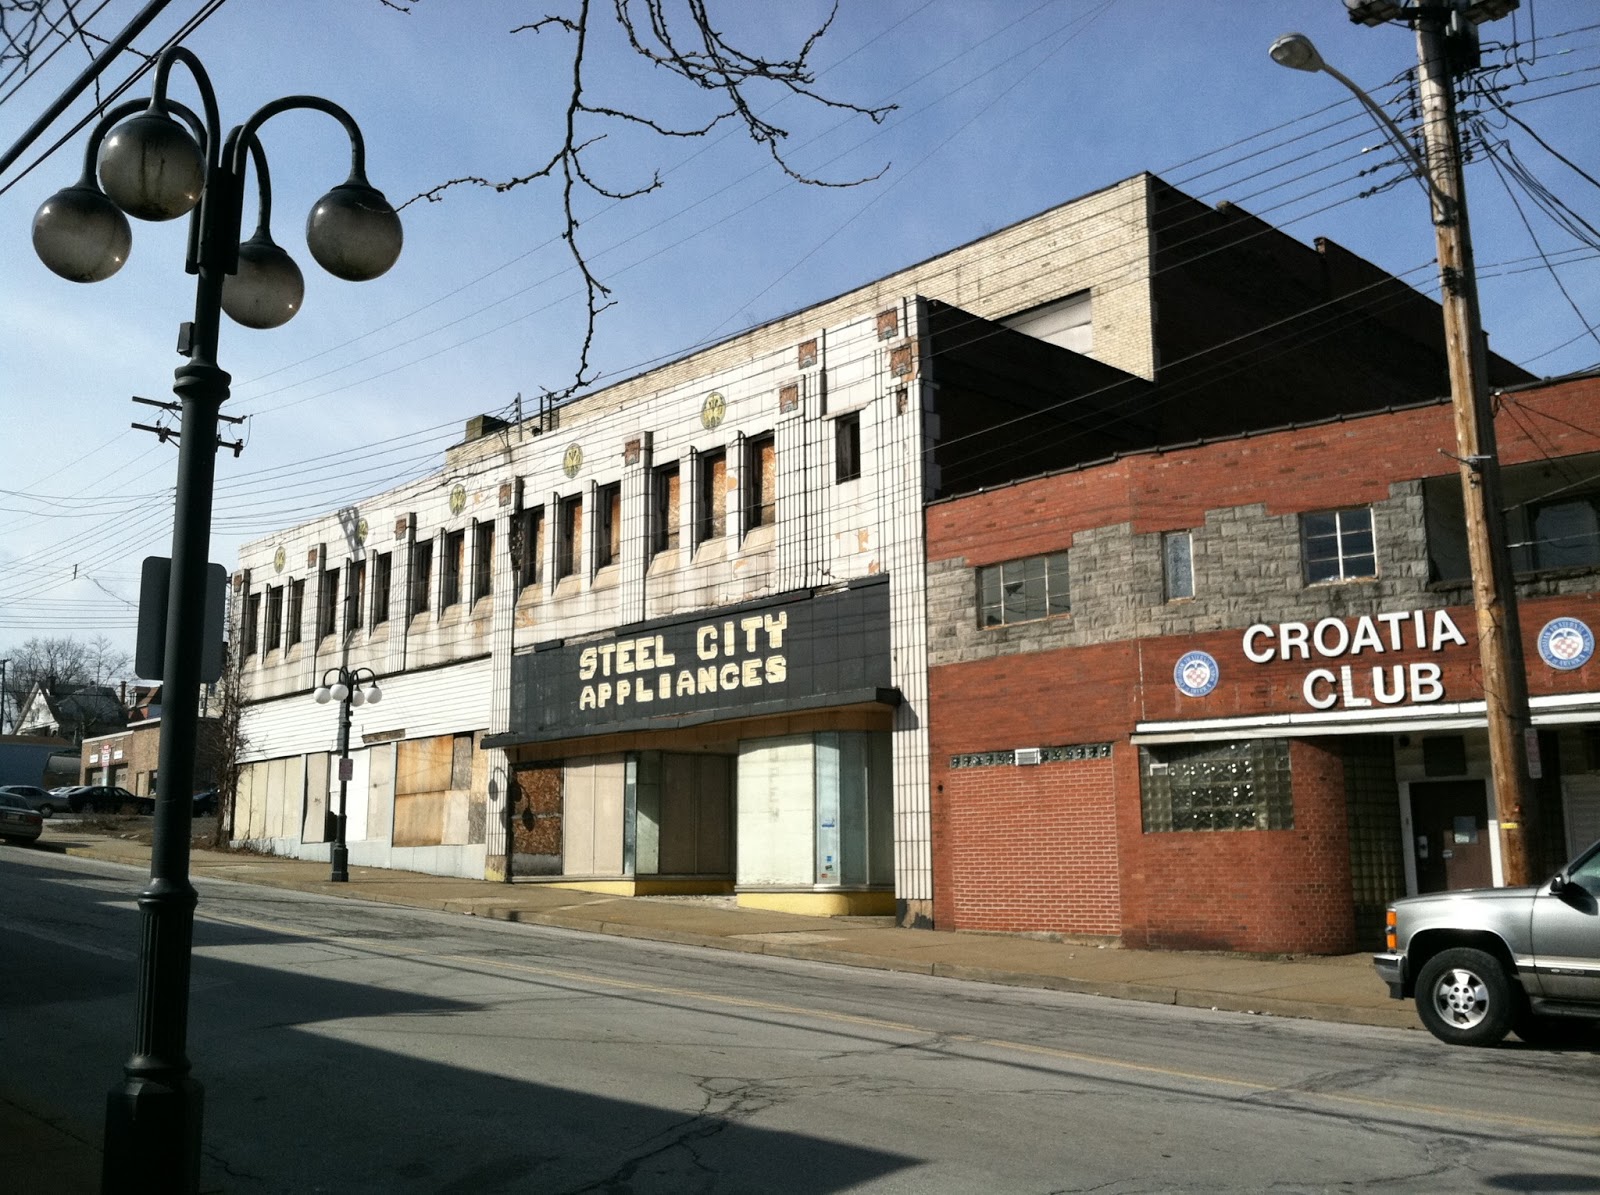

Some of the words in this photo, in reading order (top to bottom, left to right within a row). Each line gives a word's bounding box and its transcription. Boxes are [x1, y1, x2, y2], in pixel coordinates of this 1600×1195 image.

[579, 635, 676, 680] STEEL
[697, 611, 788, 660] CITY
[1242, 609, 1466, 664] CROATIA
[579, 654, 788, 711] APPLIANCES
[1303, 662, 1446, 710] CLUB
